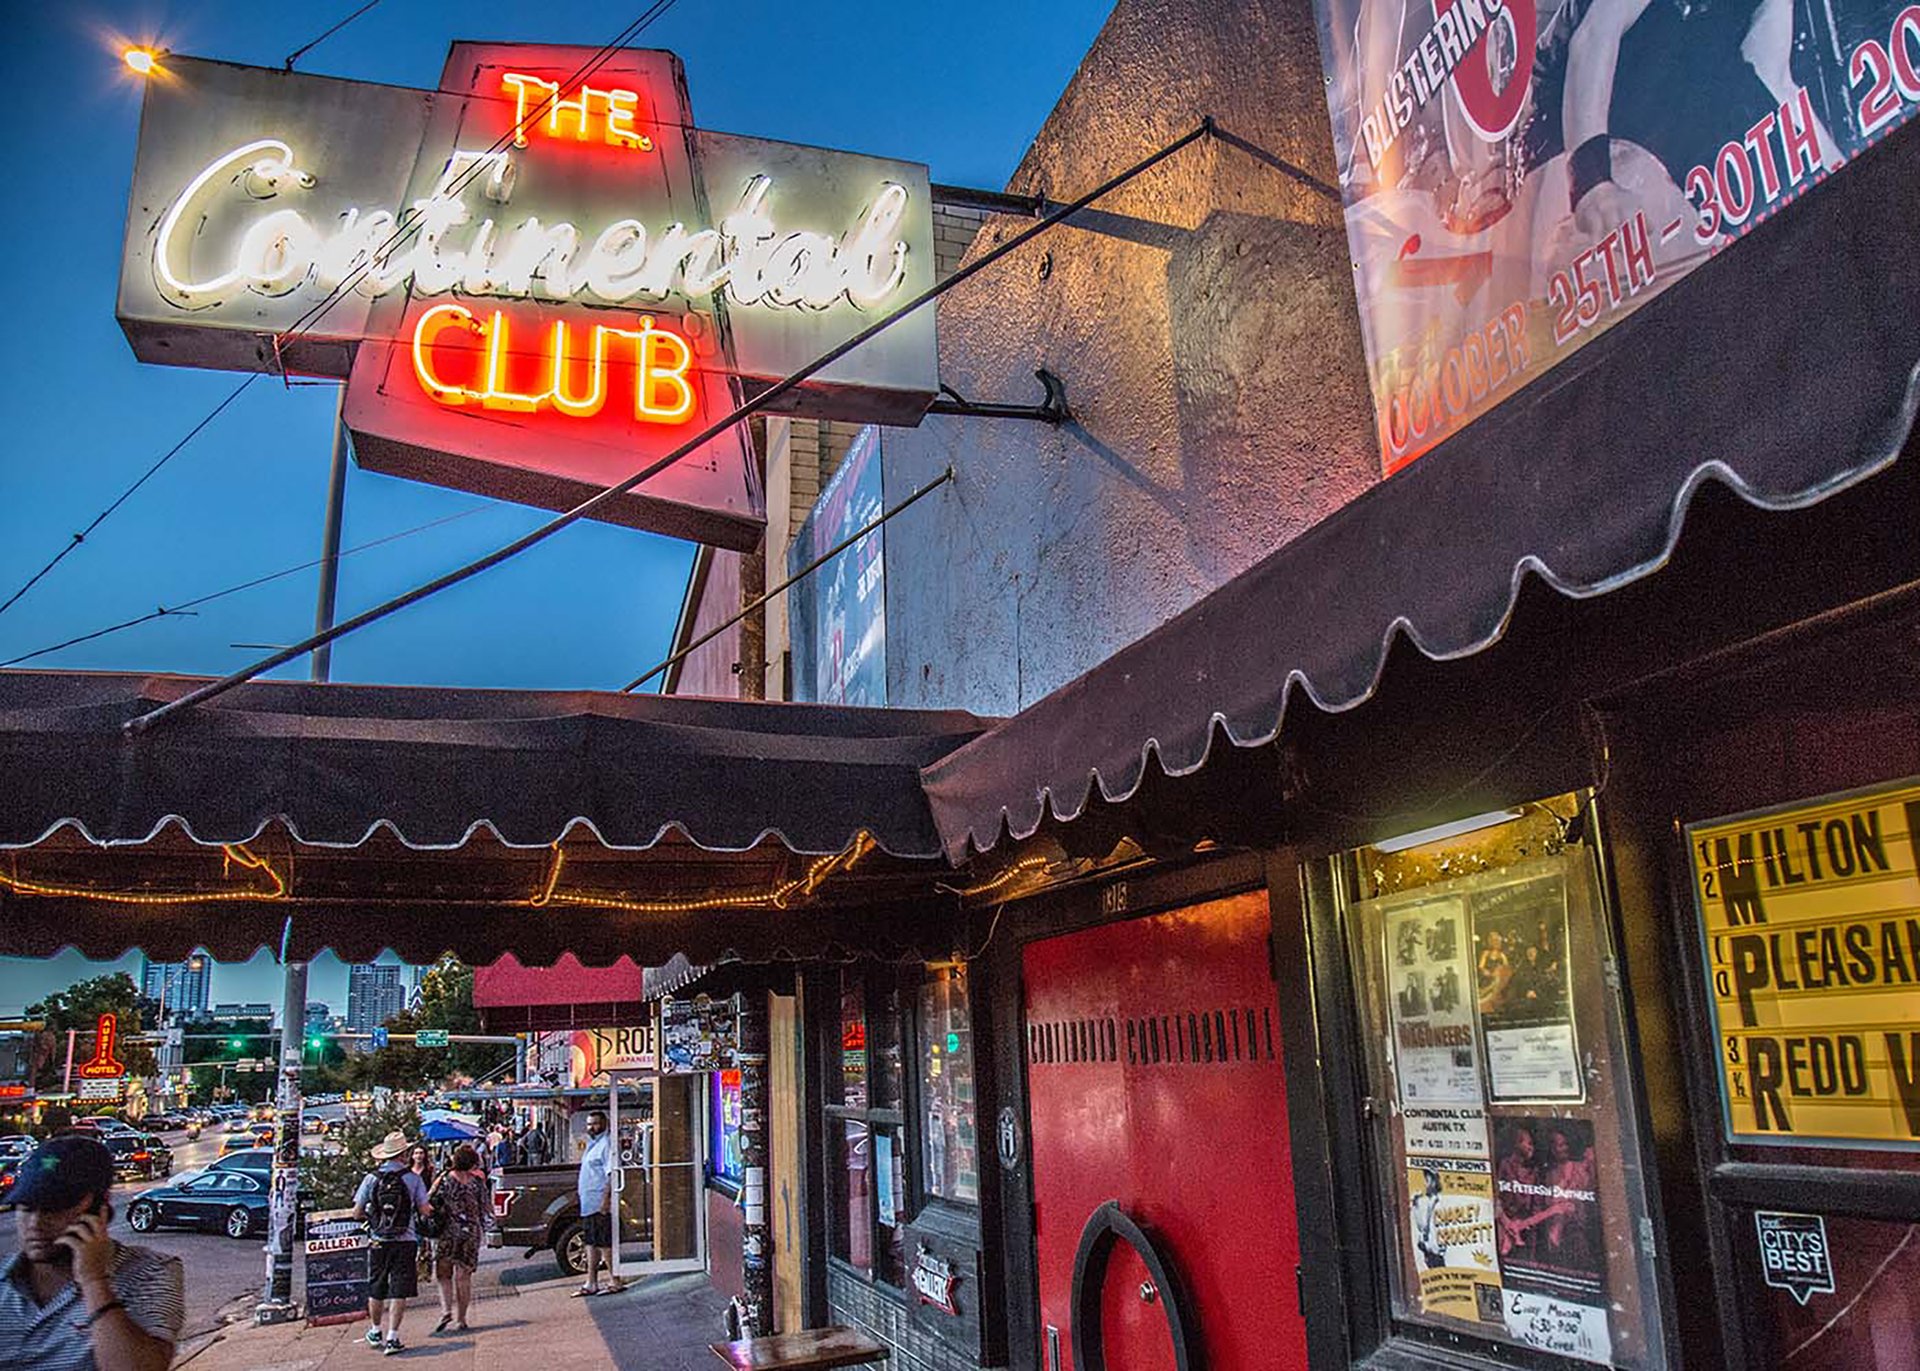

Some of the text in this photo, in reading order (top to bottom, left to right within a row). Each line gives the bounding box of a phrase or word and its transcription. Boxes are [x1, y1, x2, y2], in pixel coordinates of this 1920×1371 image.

[502, 73, 654, 151] THE
[154, 139, 910, 312] Continental
[1388, 302, 1532, 454] OCTOBER
[1548, 210, 1656, 347] 25TH
[1685, 86, 1822, 245] 30TH
[412, 302, 697, 426] CLUB
[1716, 811, 1890, 927] MILTON
[99, 1019, 111, 1065] AUSTIN
[86, 1065, 118, 1074] MOTEL
[1747, 1035, 1868, 1132] REDD
[1404, 1108, 1483, 1119] CONTINENTAL CLUB
[1453, 1122, 1466, 1132] TX
[1410, 1158, 1487, 1172] RESIDENCY SHOWS
[1512, 1180, 1552, 1196] PETERSON
[1553, 1185, 1597, 1202] BROTHERS
[1434, 1204, 1480, 1228] CHARLEY
[307, 1237, 362, 1253] GALLERY
[1437, 1223, 1493, 1248] CROCKETT
[1763, 1230, 1822, 1252] CITY'S
[1766, 1248, 1824, 1274] BEST
